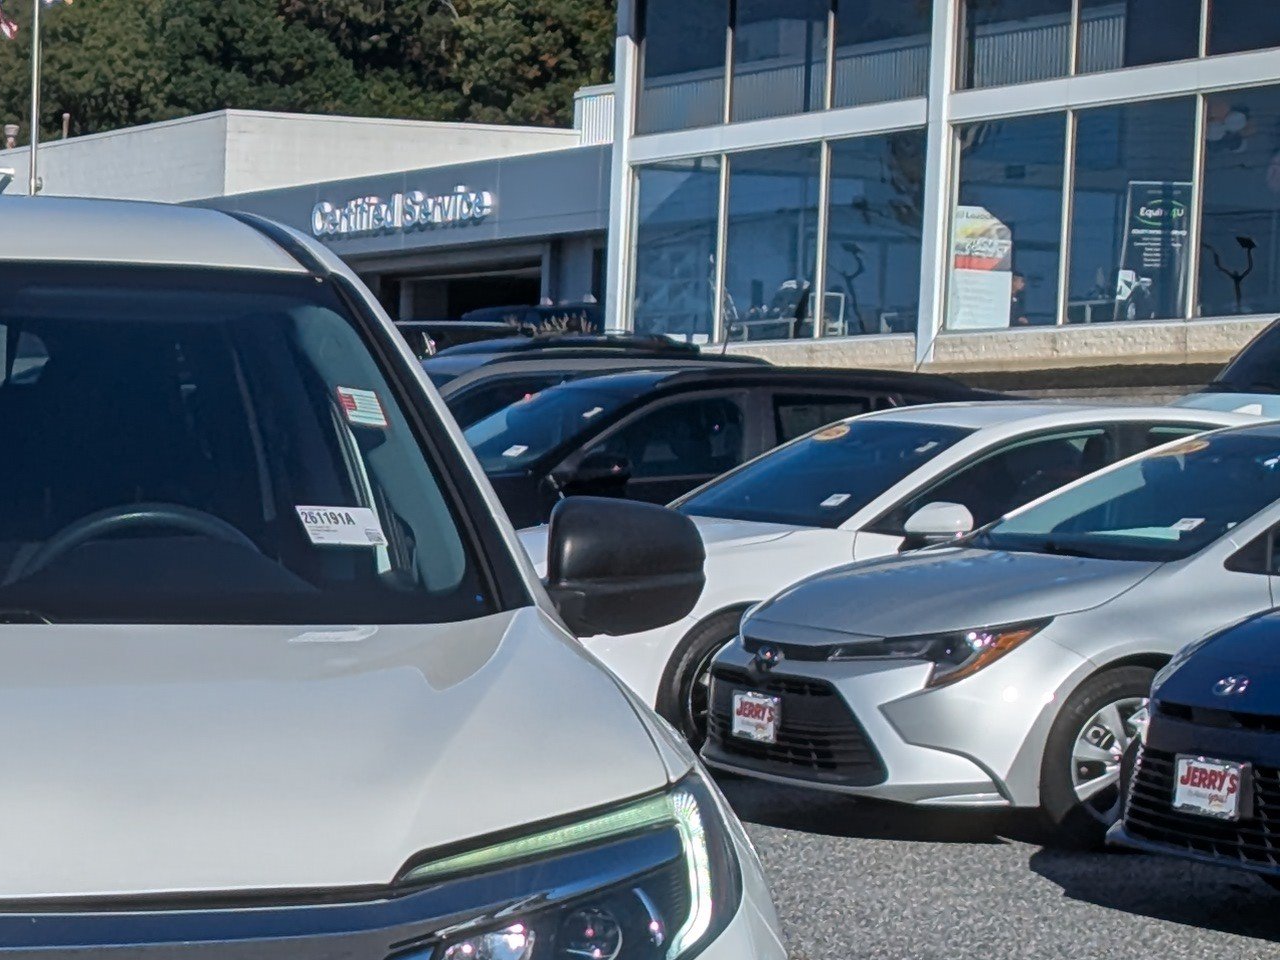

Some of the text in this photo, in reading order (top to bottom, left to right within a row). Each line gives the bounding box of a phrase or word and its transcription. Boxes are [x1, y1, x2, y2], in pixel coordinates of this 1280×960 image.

[311, 185, 493, 236] Certified Service
[301, 511, 356, 525] 261191A
[736, 699, 775, 722] JERRY'S
[1180, 765, 1238, 794] JERRY'S
